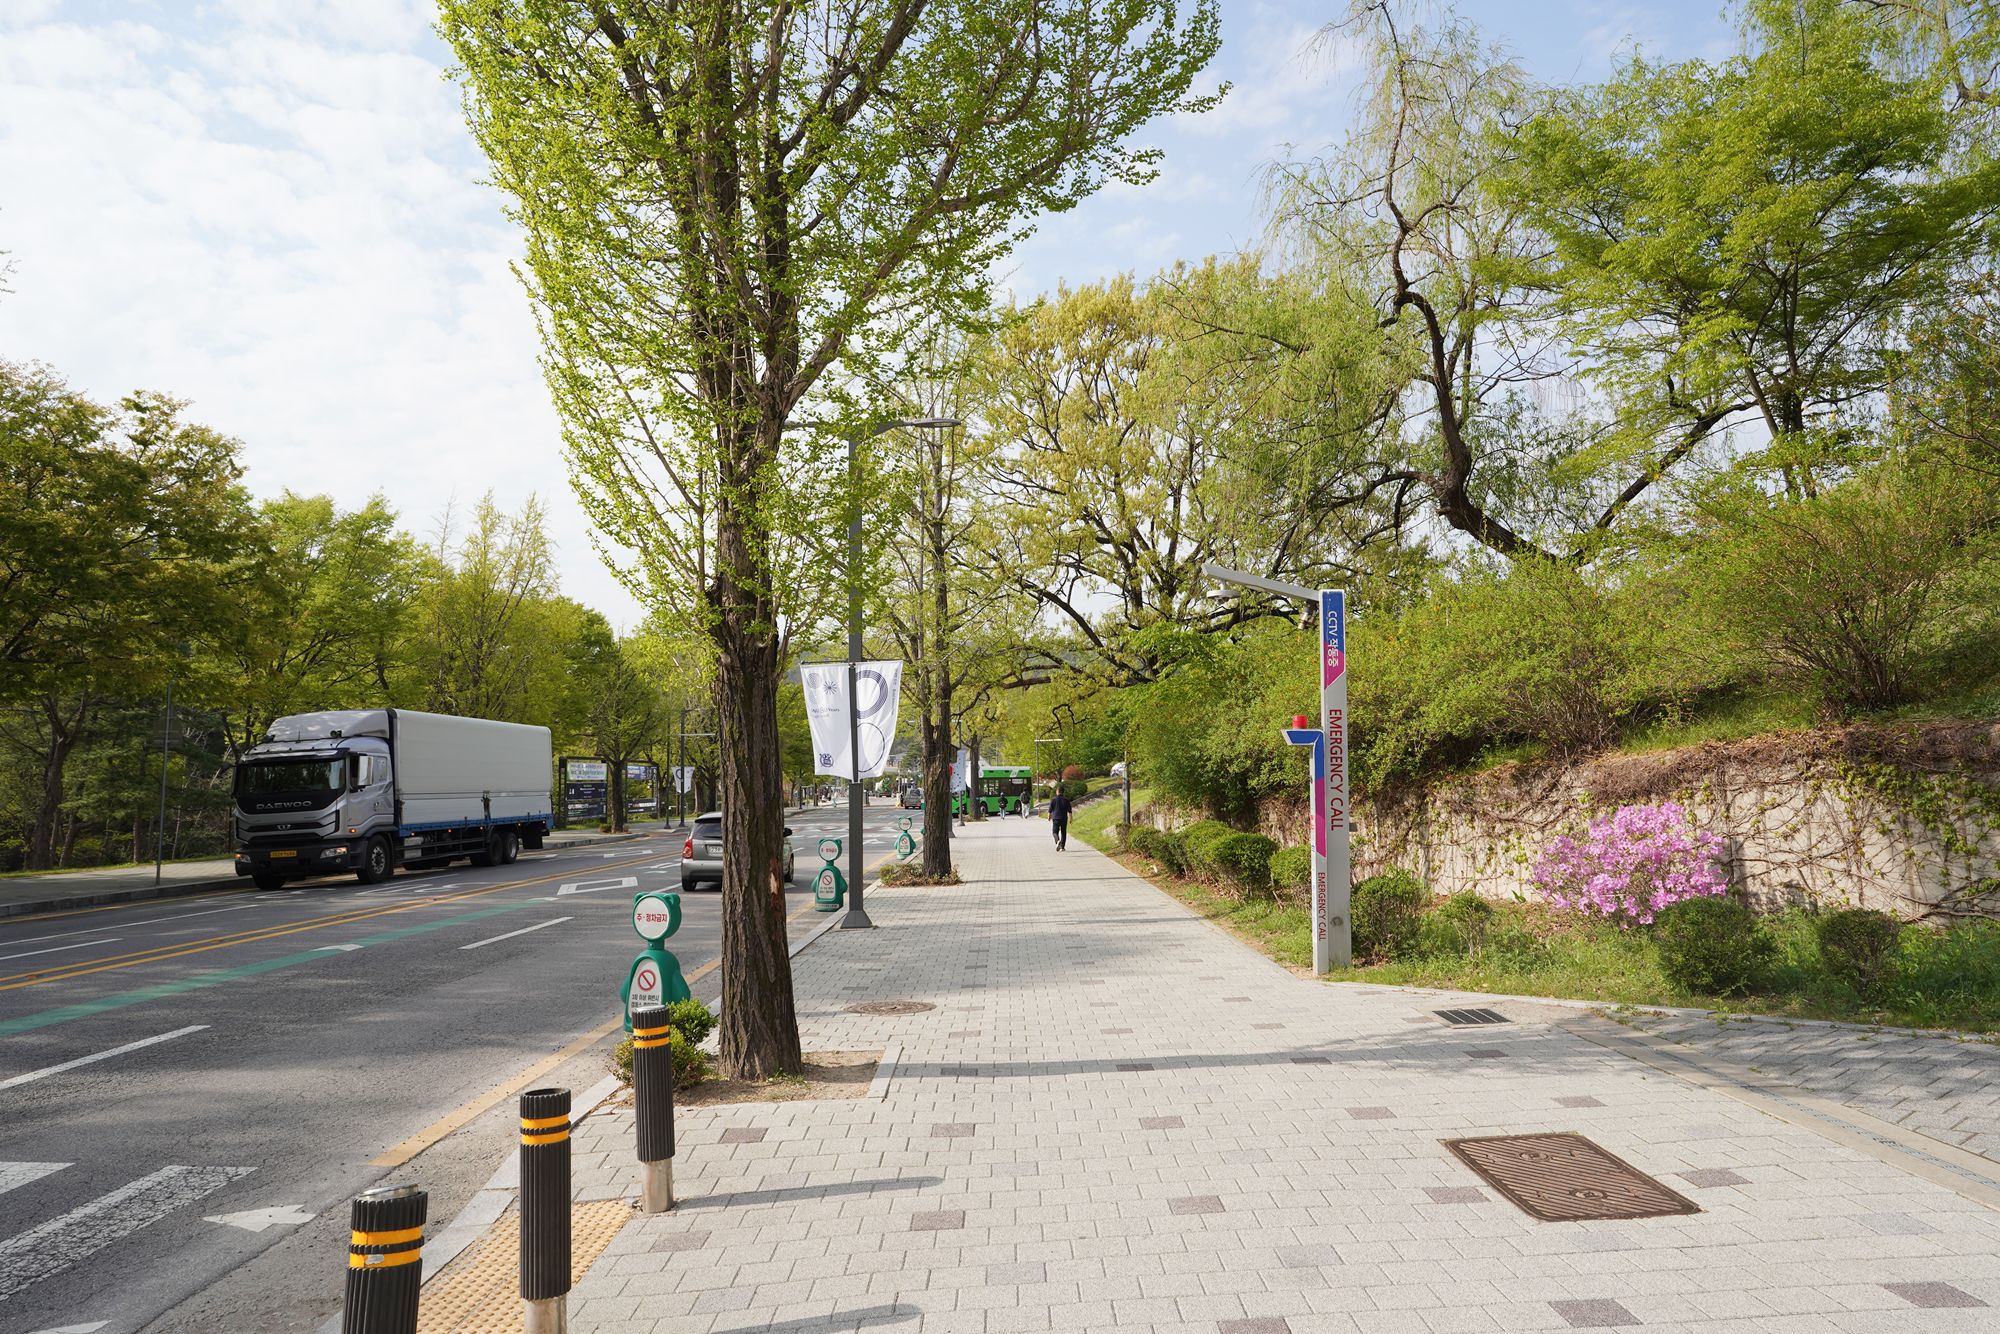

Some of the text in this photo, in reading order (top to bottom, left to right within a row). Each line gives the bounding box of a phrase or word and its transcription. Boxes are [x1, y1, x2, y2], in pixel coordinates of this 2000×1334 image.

[1328, 611, 1338, 667] CCTV 작동중
[1329, 709, 1344, 831] EMERGENCY CALL
[256, 801, 312, 810] DAEWOO
[1318, 872, 1326, 920] EMERGENCY
